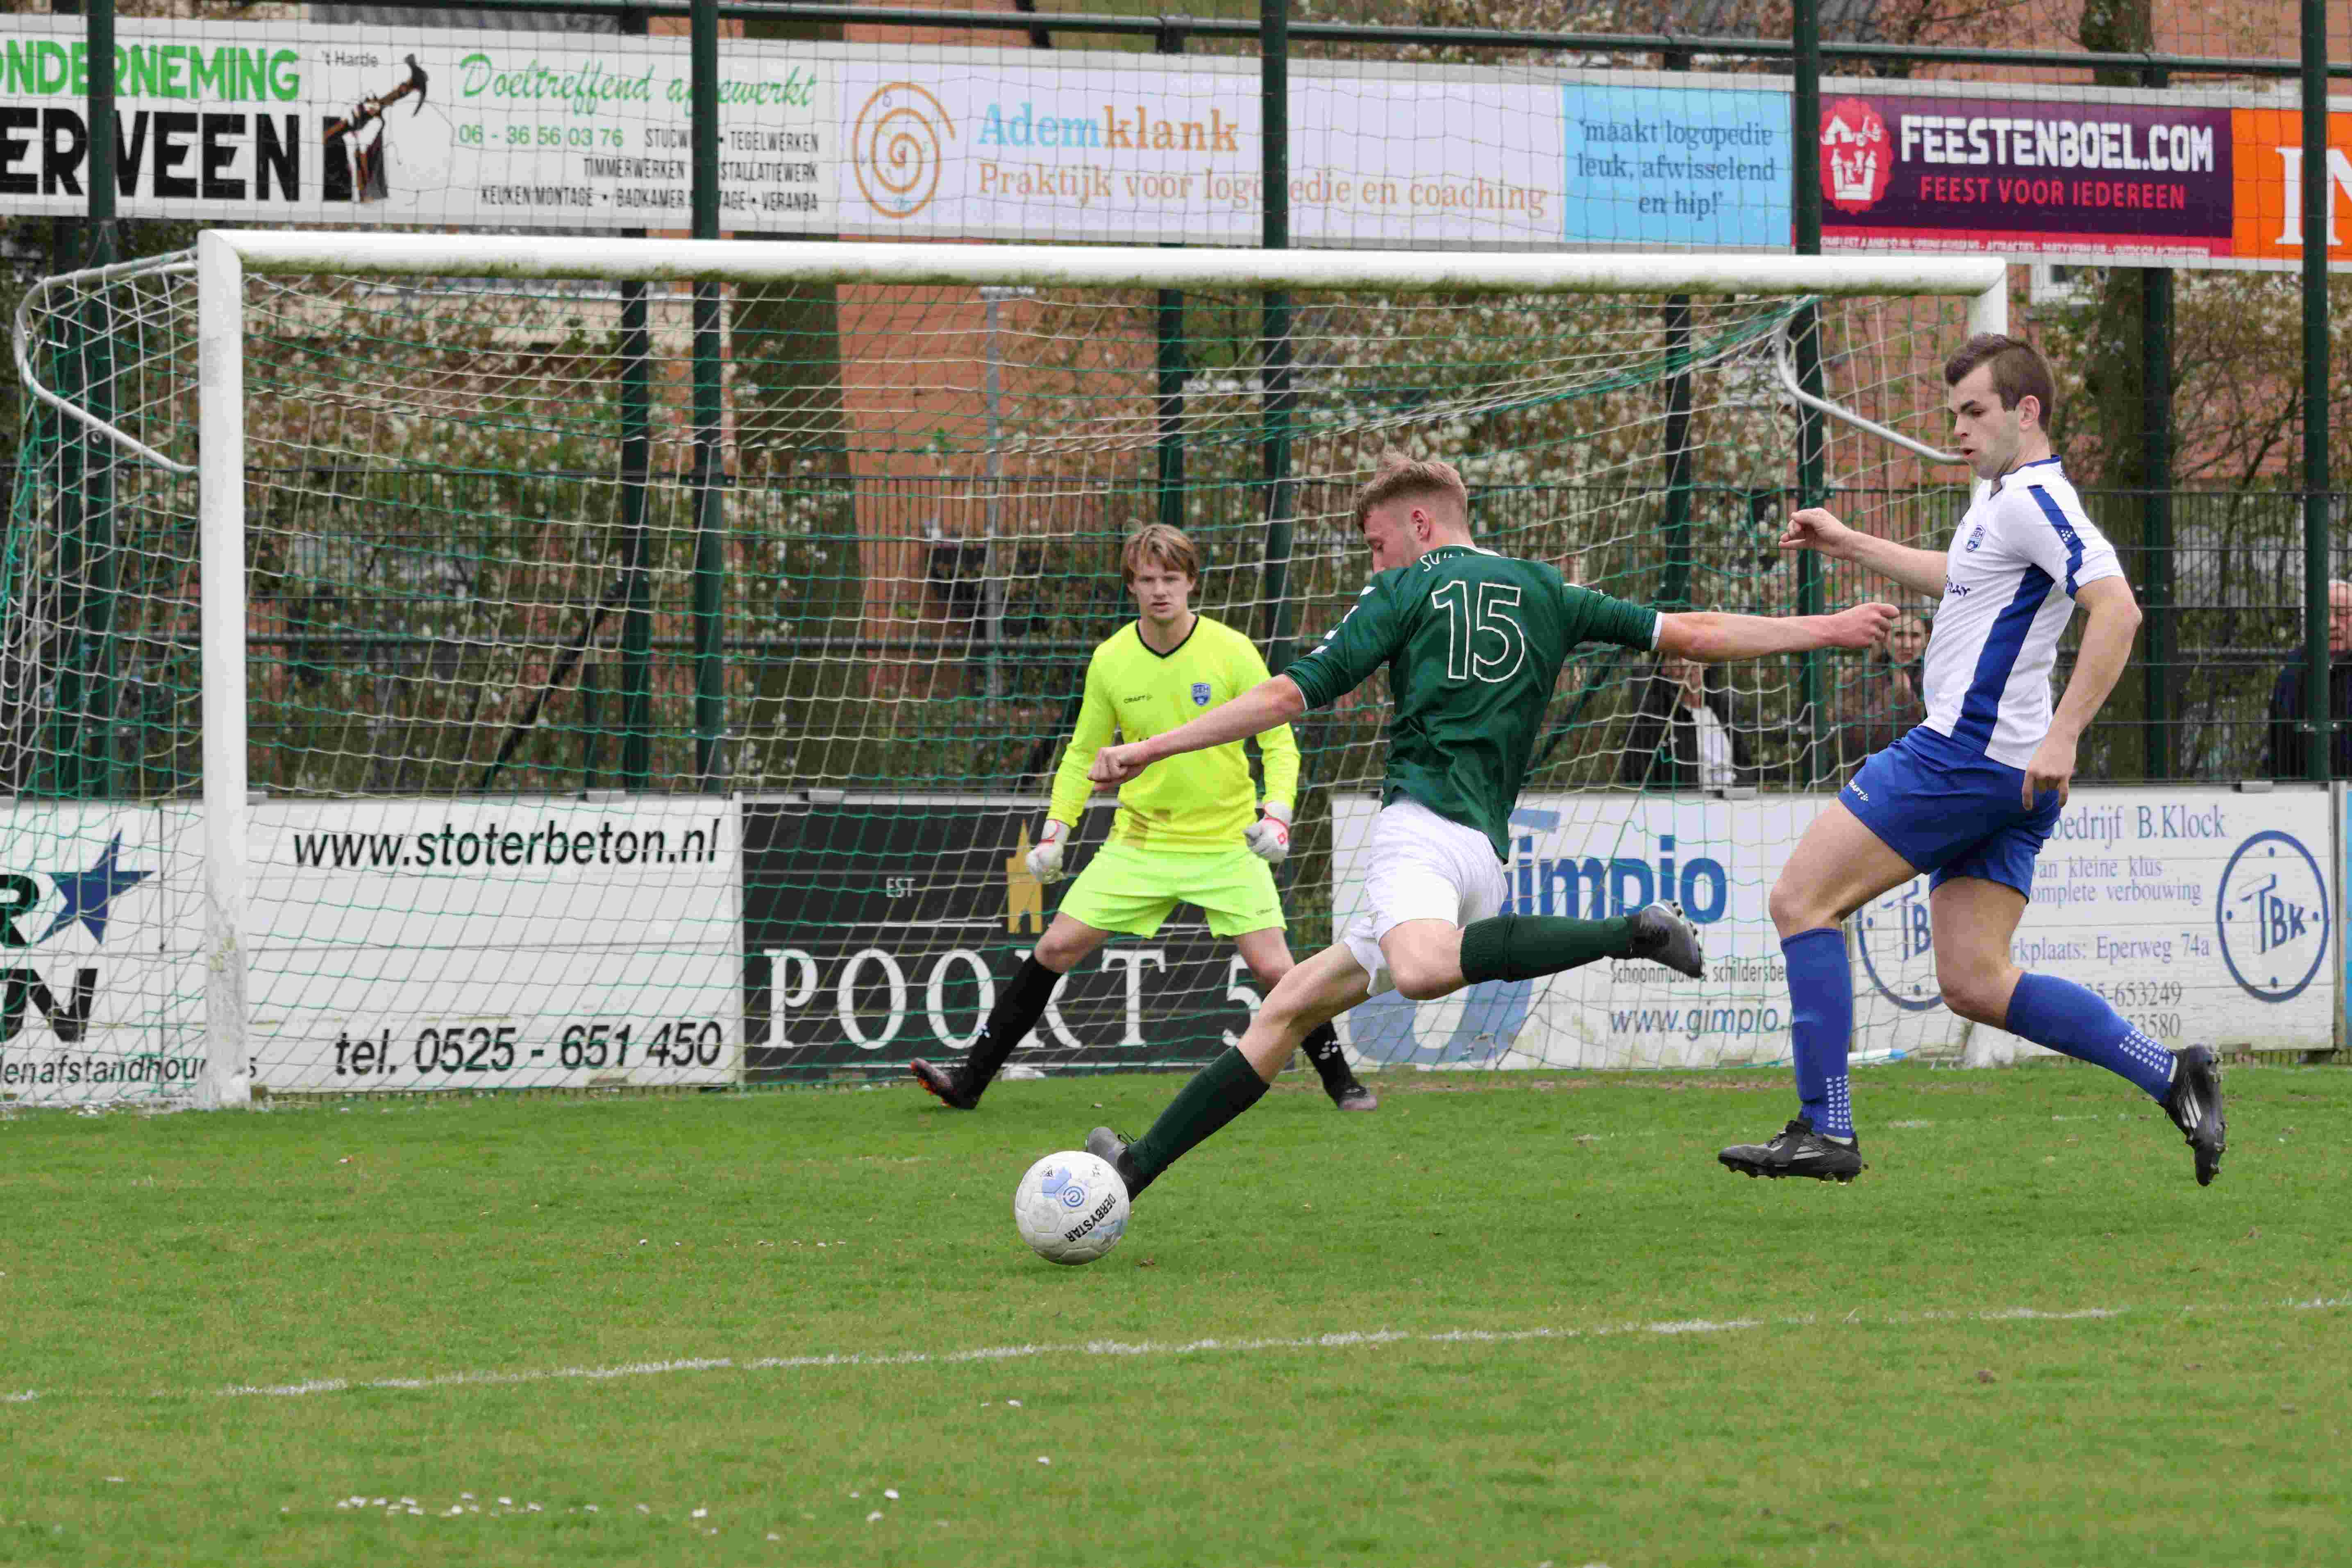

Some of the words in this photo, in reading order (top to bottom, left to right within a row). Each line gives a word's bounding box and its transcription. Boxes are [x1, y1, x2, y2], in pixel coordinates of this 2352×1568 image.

[0, 39, 300, 102] NDERNEMING
[459, 54, 655, 115] Doeltreffend
[667, 65, 816, 118] aewerkt
[459, 124, 483, 145] 06
[506, 125, 532, 146] 36
[537, 125, 561, 146] 56
[568, 127, 593, 147] 03
[599, 127, 624, 148] 76
[645, 128, 692, 149] STUCW
[729, 131, 819, 152] TEGELWERKEN
[978, 102, 1238, 151] Ademklank
[1666, 119, 1773, 151] logopedie
[1900, 114, 2214, 172] FEESTENBOEL.COM
[584, 158, 684, 179] TIMMERWERKEN
[720, 161, 818, 182] STALLATIEWERK
[978, 163, 1112, 206] Praktijk
[1125, 174, 1193, 199] voor
[1203, 168, 1351, 209] logoedie
[1362, 181, 1396, 204] en
[1410, 177, 1548, 218] coaching
[1577, 153, 1634, 180] leuk,
[1642, 154, 1775, 181] afwisselend
[1639, 195, 1666, 213] en
[1921, 176, 1991, 204] FEEST
[1997, 178, 2065, 205] VOOR
[2073, 180, 2186, 210] IEDEREEN
[1430, 580, 1526, 683] 15
[294, 818, 721, 867] www.stoterbeton.nl
[2069, 856, 2118, 879] kleine
[2129, 855, 2163, 877] klus
[885, 877, 916, 898] EST
[1499, 834, 1727, 925] impio
[2031, 880, 2096, 909] omplete
[2106, 877, 2202, 906] verbouwing
[1881, 879, 1932, 964] TB
[2239, 873, 2307, 955] TBK
[2011, 937, 2087, 967] rkplaats:
[2096, 935, 2173, 965] Eperweg
[2181, 930, 2210, 958] 74a
[335, 1029, 397, 1076] tel.
[415, 1027, 517, 1074] 0525
[560, 1024, 629, 1068] 651
[647, 1021, 722, 1067] 450
[1064, 1193, 1117, 1242] DERBYSTAR
